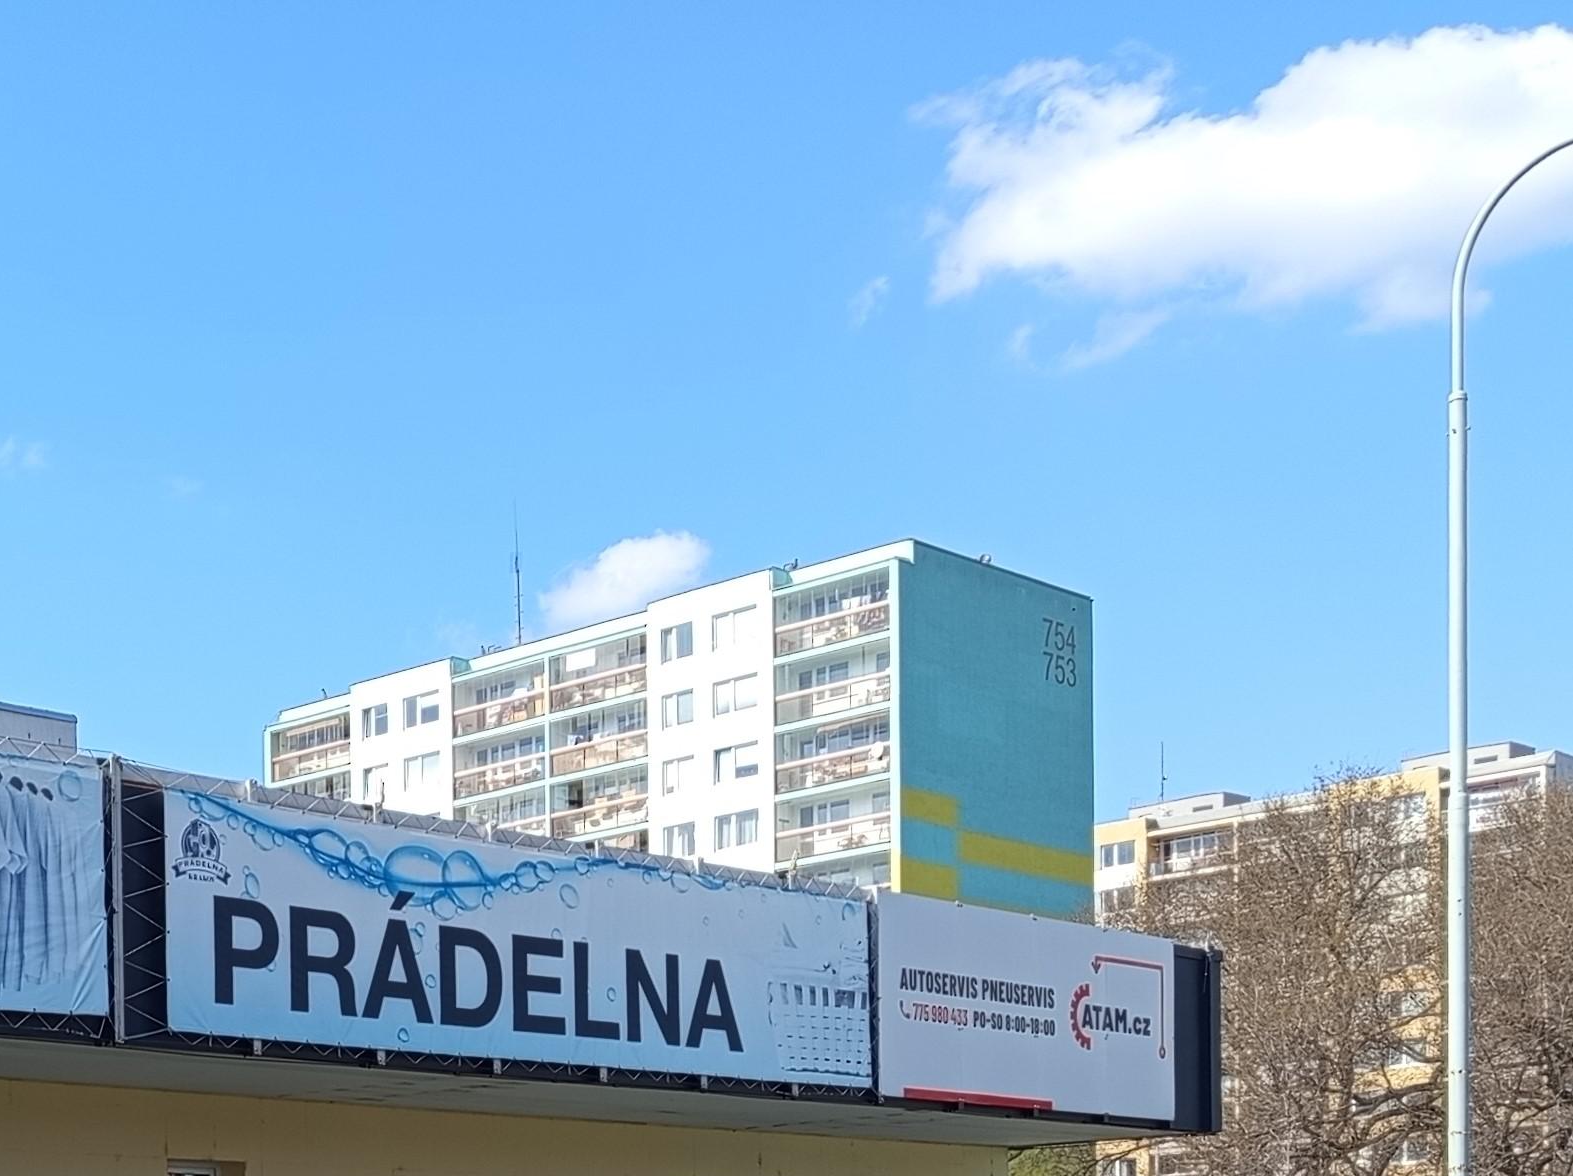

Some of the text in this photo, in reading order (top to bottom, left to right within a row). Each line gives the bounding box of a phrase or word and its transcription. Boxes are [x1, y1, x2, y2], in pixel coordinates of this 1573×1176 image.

[1042, 617, 1076, 656] 754
[1042, 651, 1077, 688] 753
[213, 890, 745, 1053] PRÁDELNA
[899, 967, 1055, 1009] AUTOSERVIS PNEUSERVIS
[912, 1003, 1056, 1037] 775 980 433 PO-SO 8:00-18:00
[1081, 1003, 1151, 1037] ATAM.cz
